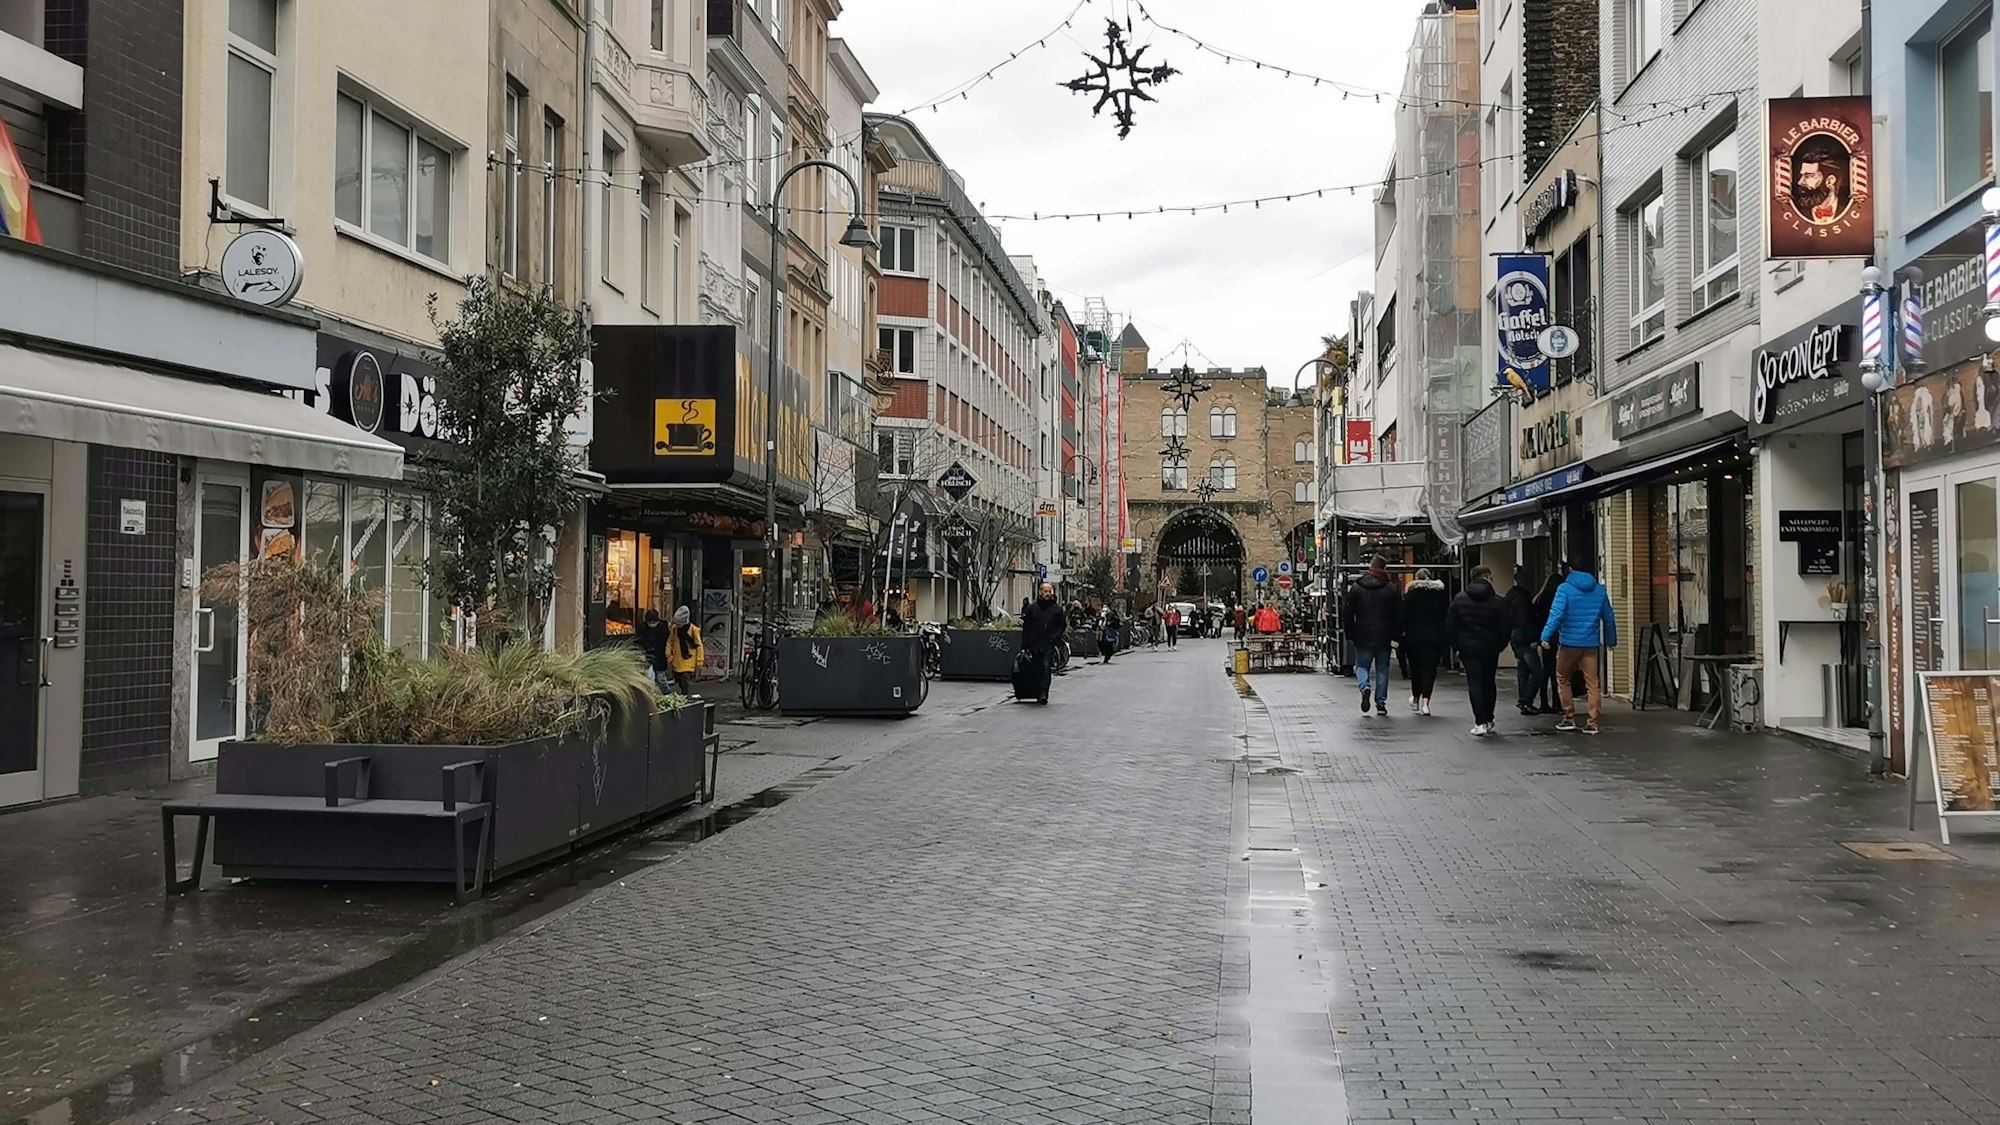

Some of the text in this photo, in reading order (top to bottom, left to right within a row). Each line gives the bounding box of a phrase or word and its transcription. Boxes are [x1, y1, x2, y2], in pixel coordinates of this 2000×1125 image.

[1782, 117, 1861, 146] LE BARBIER
[1782, 210, 1861, 238] CLASSIC
[1934, 253, 1986, 308] BARBIER
[1497, 308, 1548, 331] Gaffel
[1931, 303, 1973, 342] CLASSIC
[1040, 501, 1055, 510] dm
